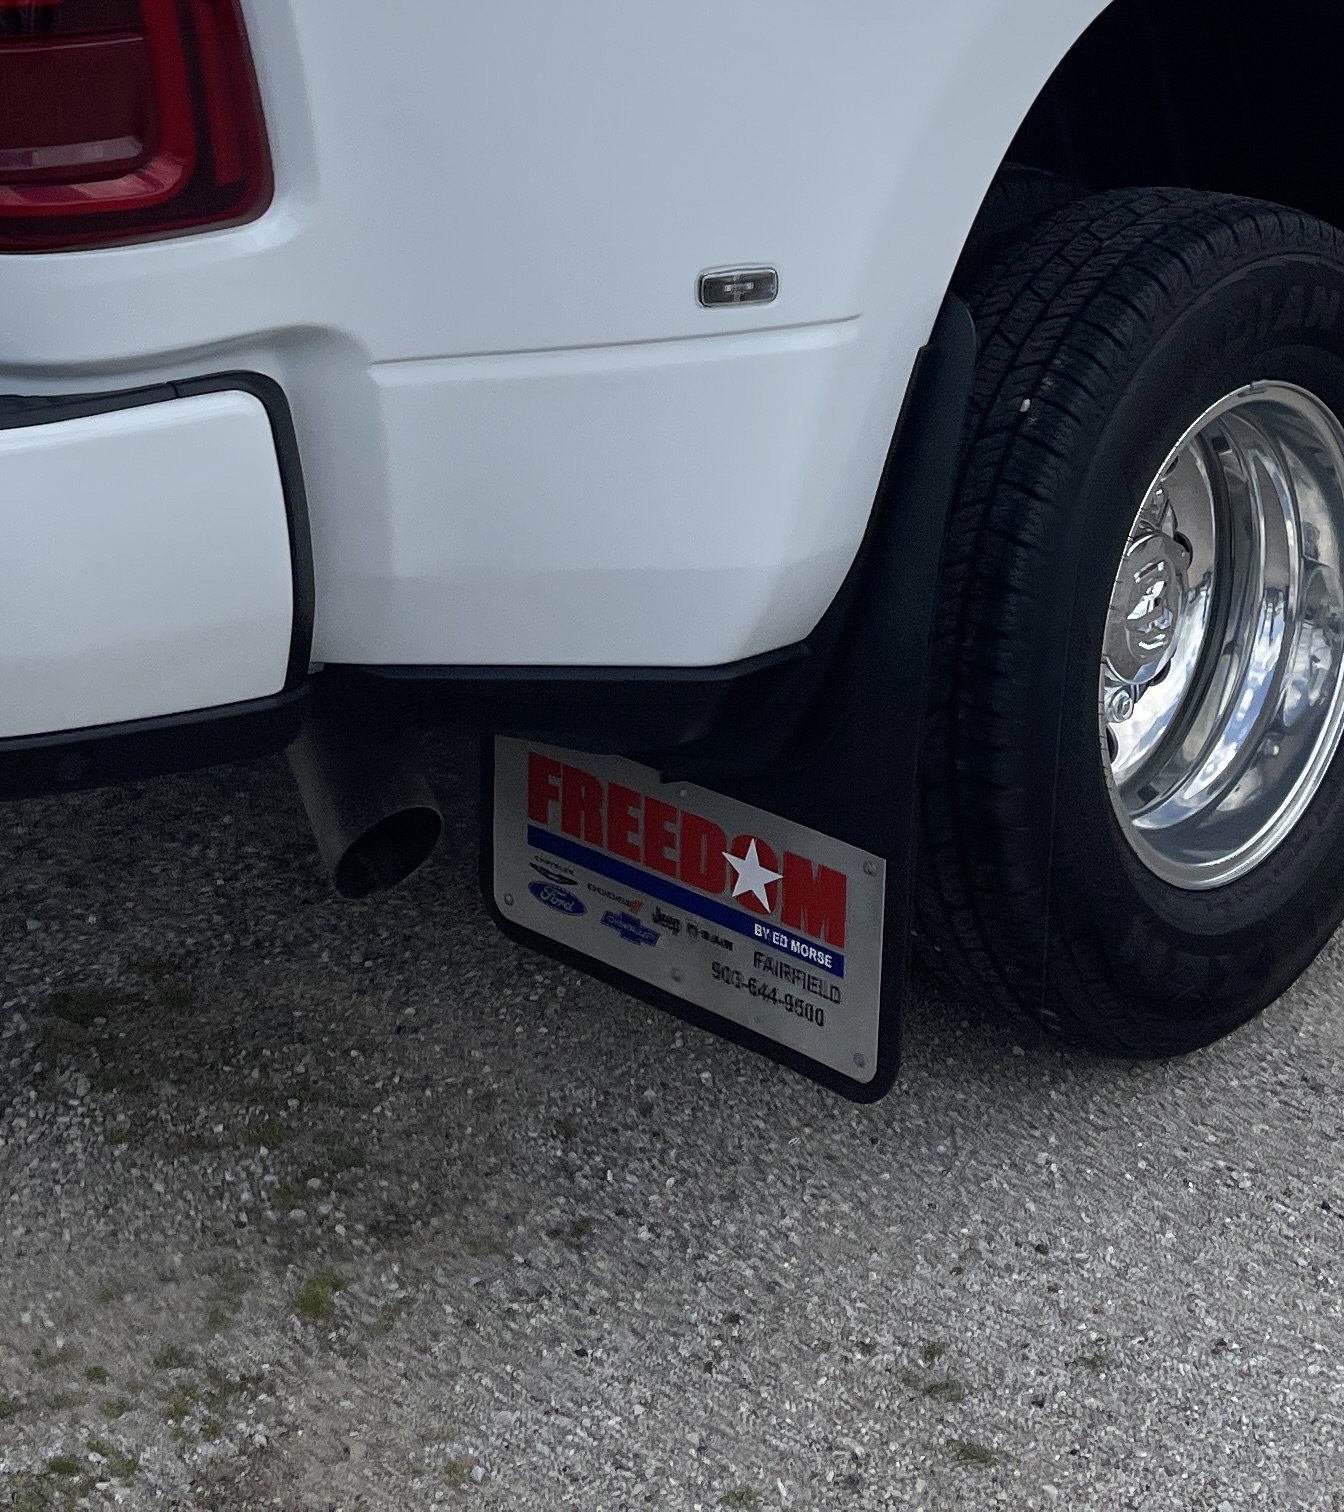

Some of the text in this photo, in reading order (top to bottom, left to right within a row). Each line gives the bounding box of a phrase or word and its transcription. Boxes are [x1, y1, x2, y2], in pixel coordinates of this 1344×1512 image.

[527, 751, 847, 949] FREEDOM
[540, 884, 574, 912] Ford
[754, 923, 833, 969] BY ED MORSE
[753, 951, 842, 1005] FAIRFIELD
